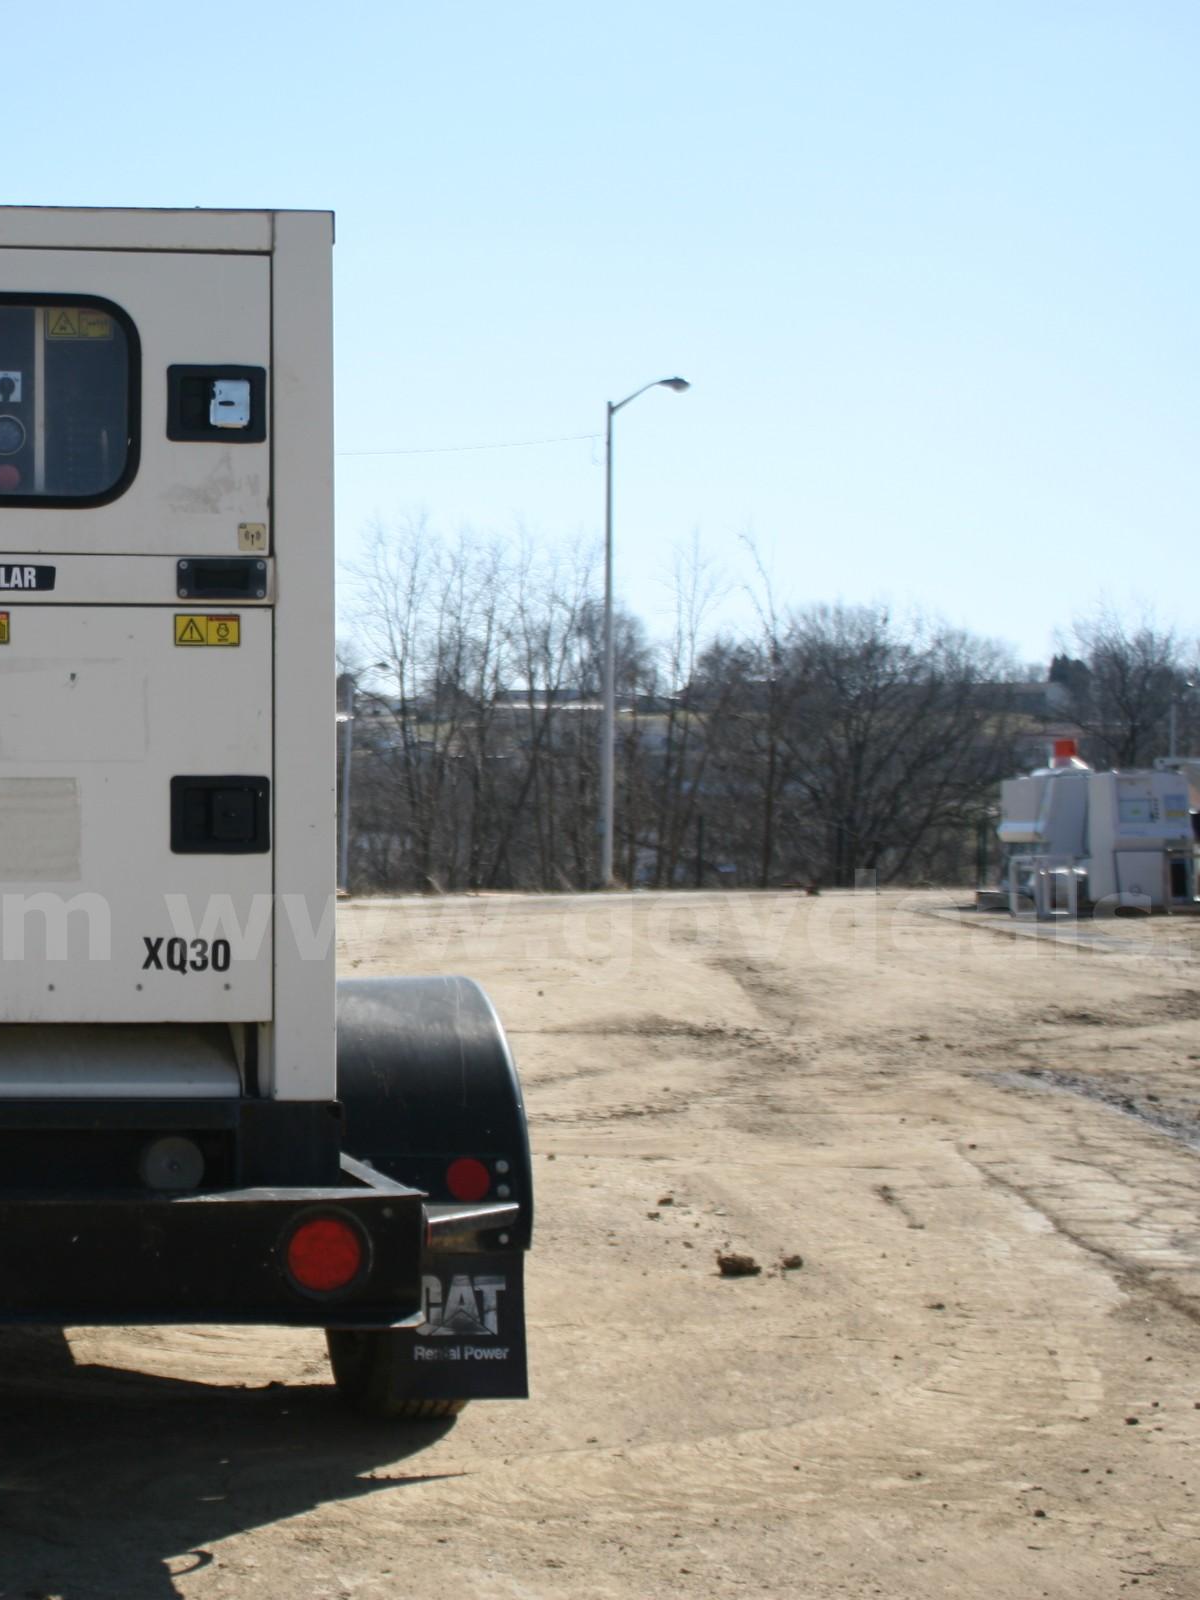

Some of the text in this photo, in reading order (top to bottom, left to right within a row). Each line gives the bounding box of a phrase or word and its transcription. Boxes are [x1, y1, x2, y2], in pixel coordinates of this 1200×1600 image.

[142, 936, 231, 975] XQ30
[416, 1274, 506, 1336] CAT
[413, 1345, 509, 1361] Real Power
